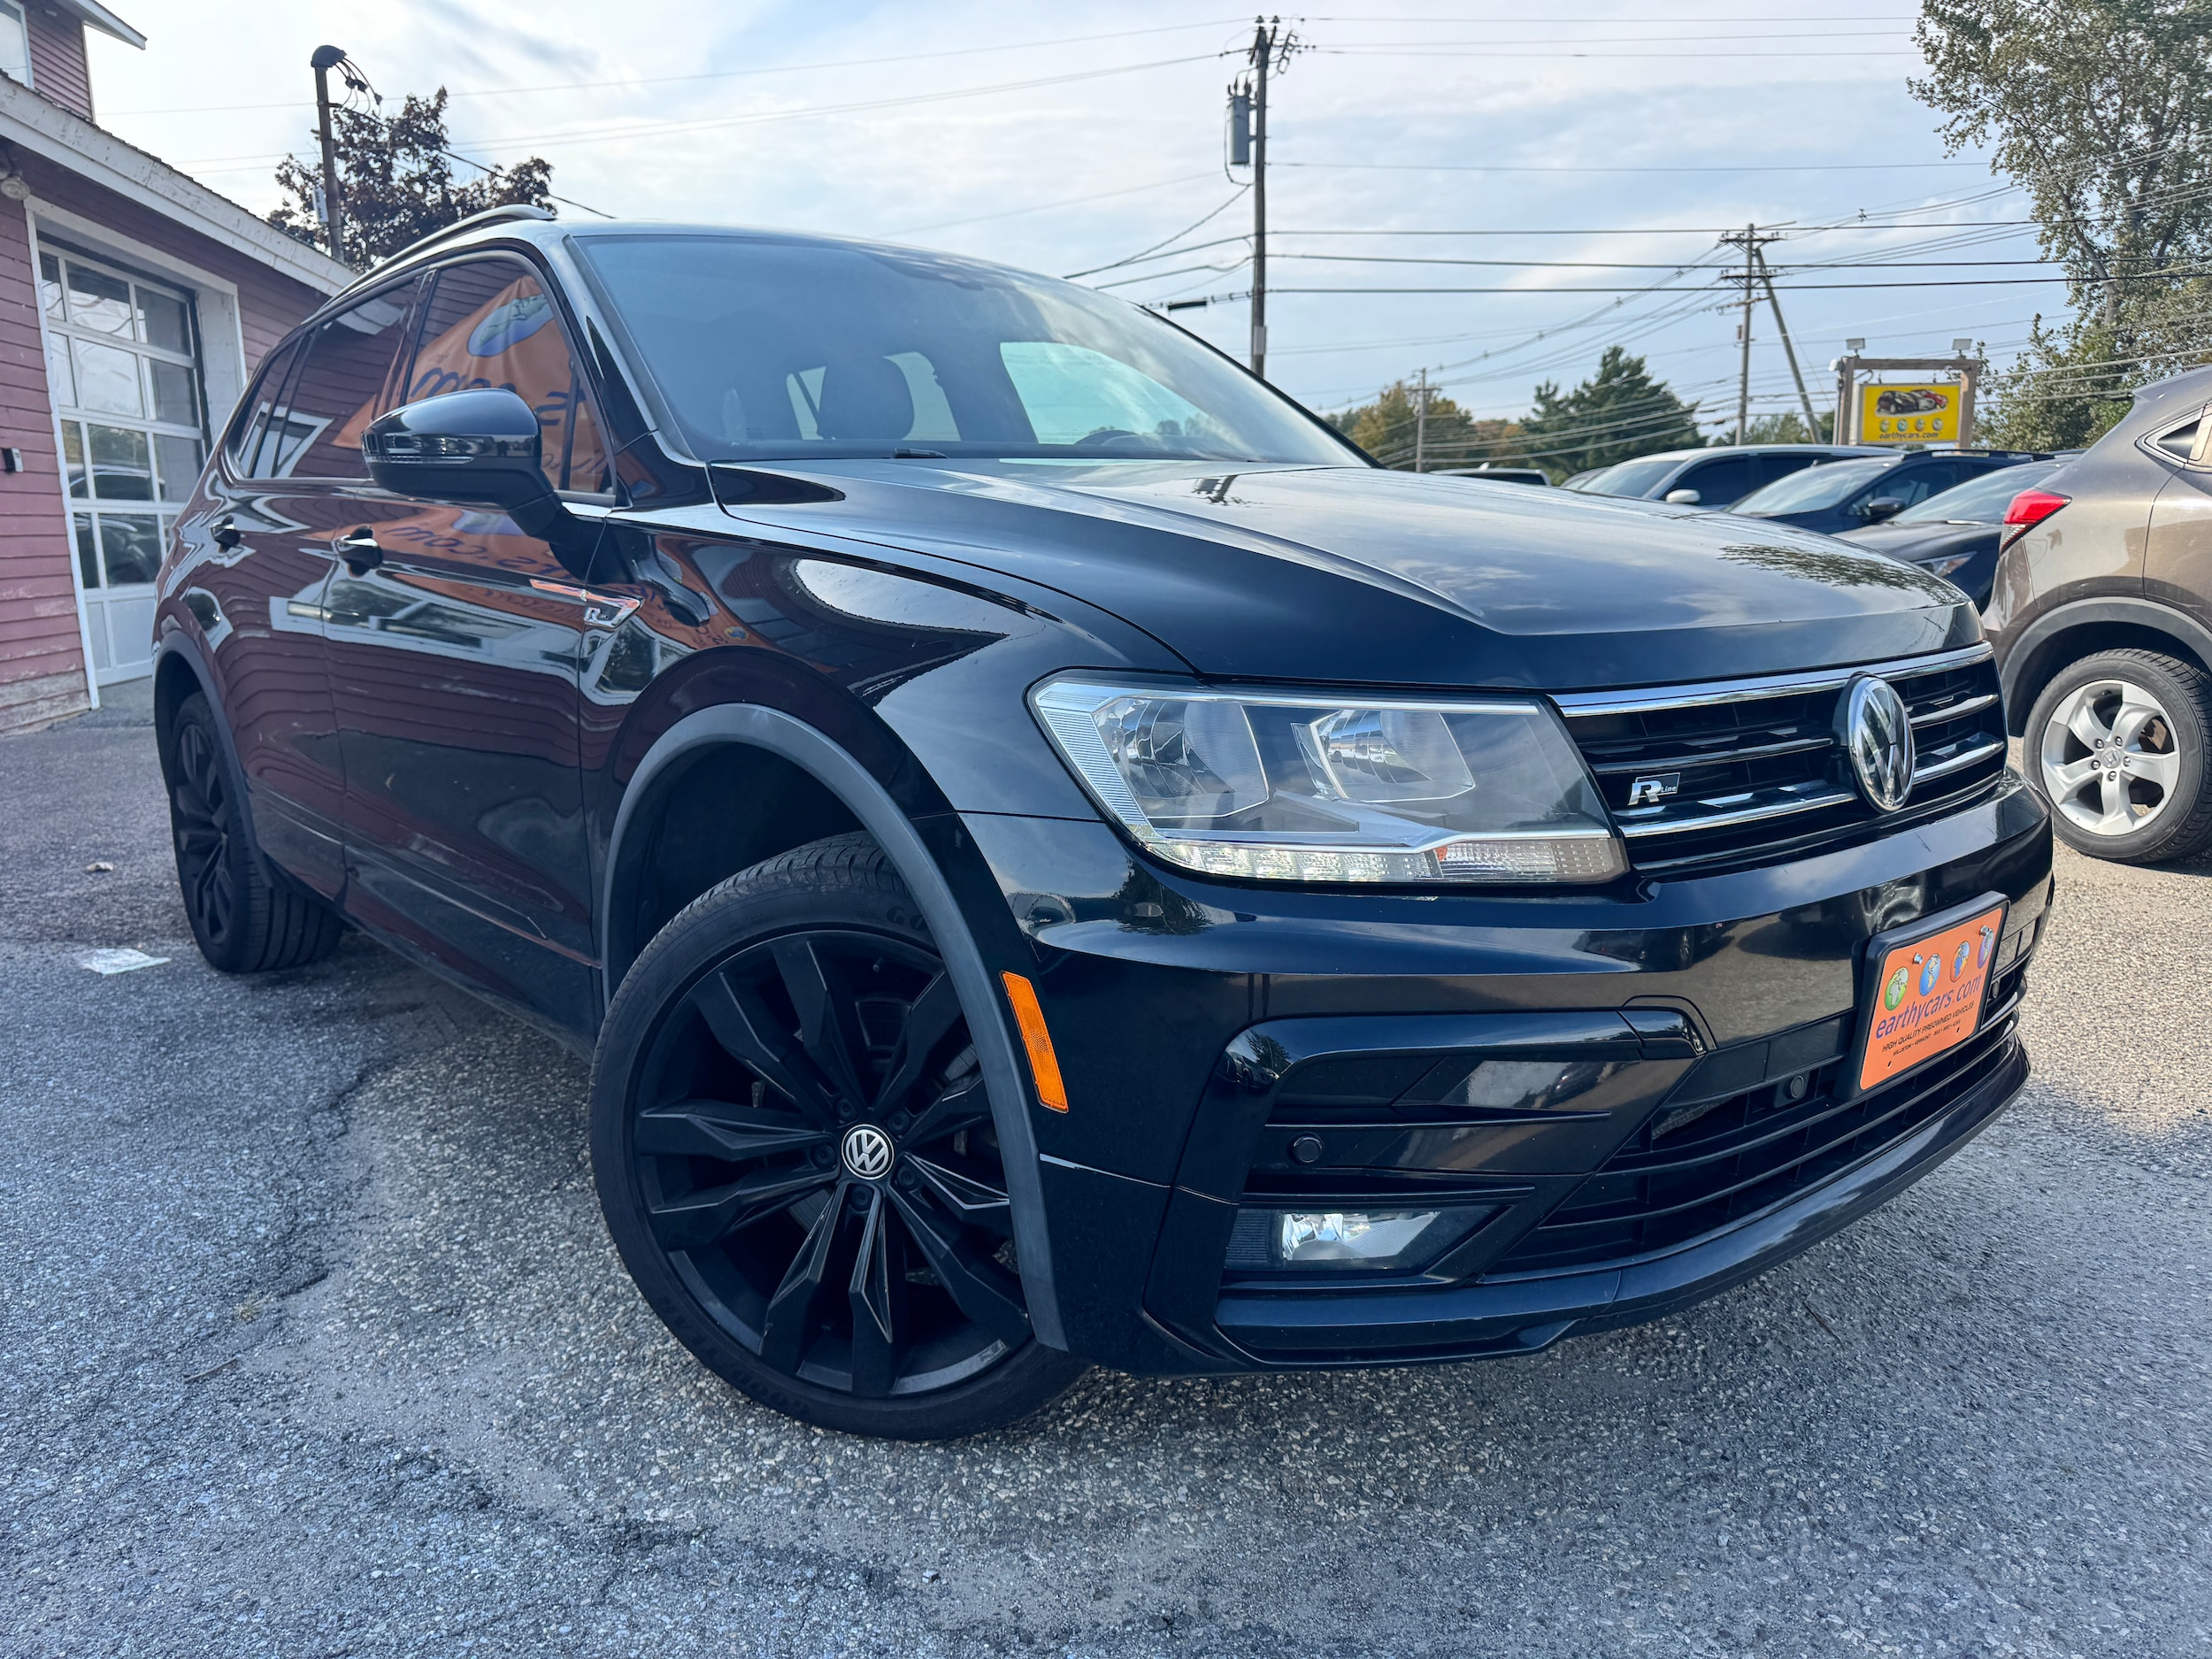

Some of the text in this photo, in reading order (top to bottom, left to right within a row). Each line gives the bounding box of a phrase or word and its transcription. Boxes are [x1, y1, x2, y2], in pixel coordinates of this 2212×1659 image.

[1879, 431, 1939, 441] earthycars.com
[1876, 974, 1981, 1039] earthycars.com
[1882, 1039, 1898, 1053] HIGH
[1898, 1027, 1921, 1045] QUALITY
[1952, 1001, 1975, 1019] VEHICLES
